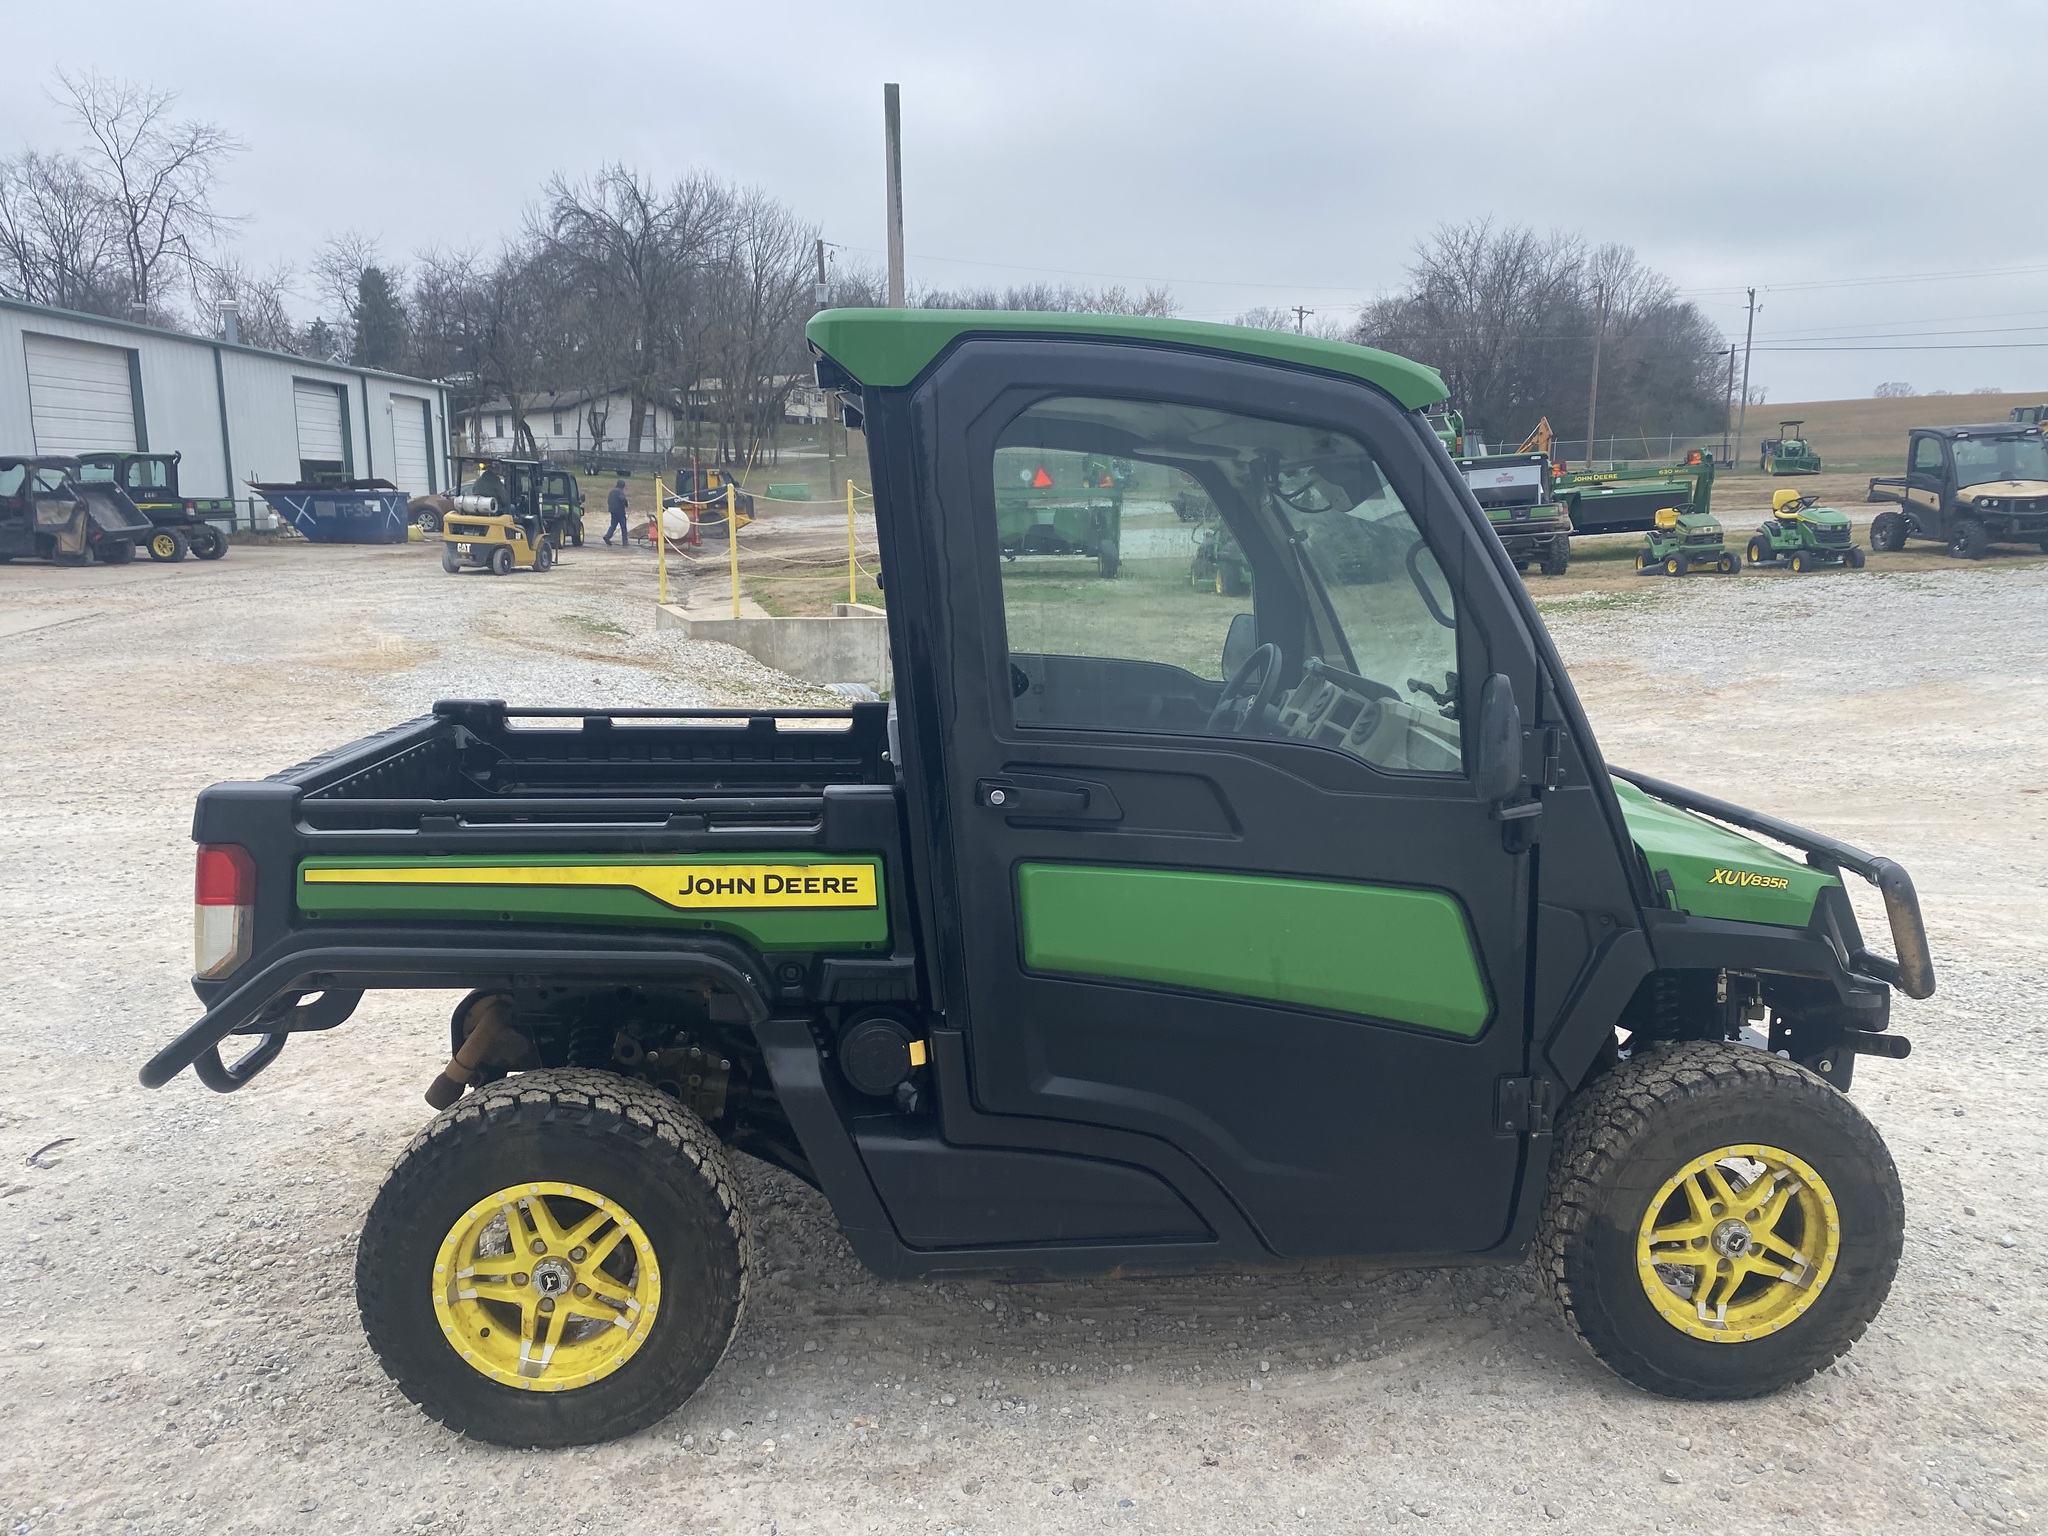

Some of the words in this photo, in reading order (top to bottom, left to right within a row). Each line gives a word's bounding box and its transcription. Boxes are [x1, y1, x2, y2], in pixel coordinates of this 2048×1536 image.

[1573, 475, 1592, 483] JOHN
[457, 542, 471, 553] CAT
[678, 874, 756, 895] JOHN
[763, 874, 859, 894] DEERE
[1708, 868, 1789, 890] XUV835R
